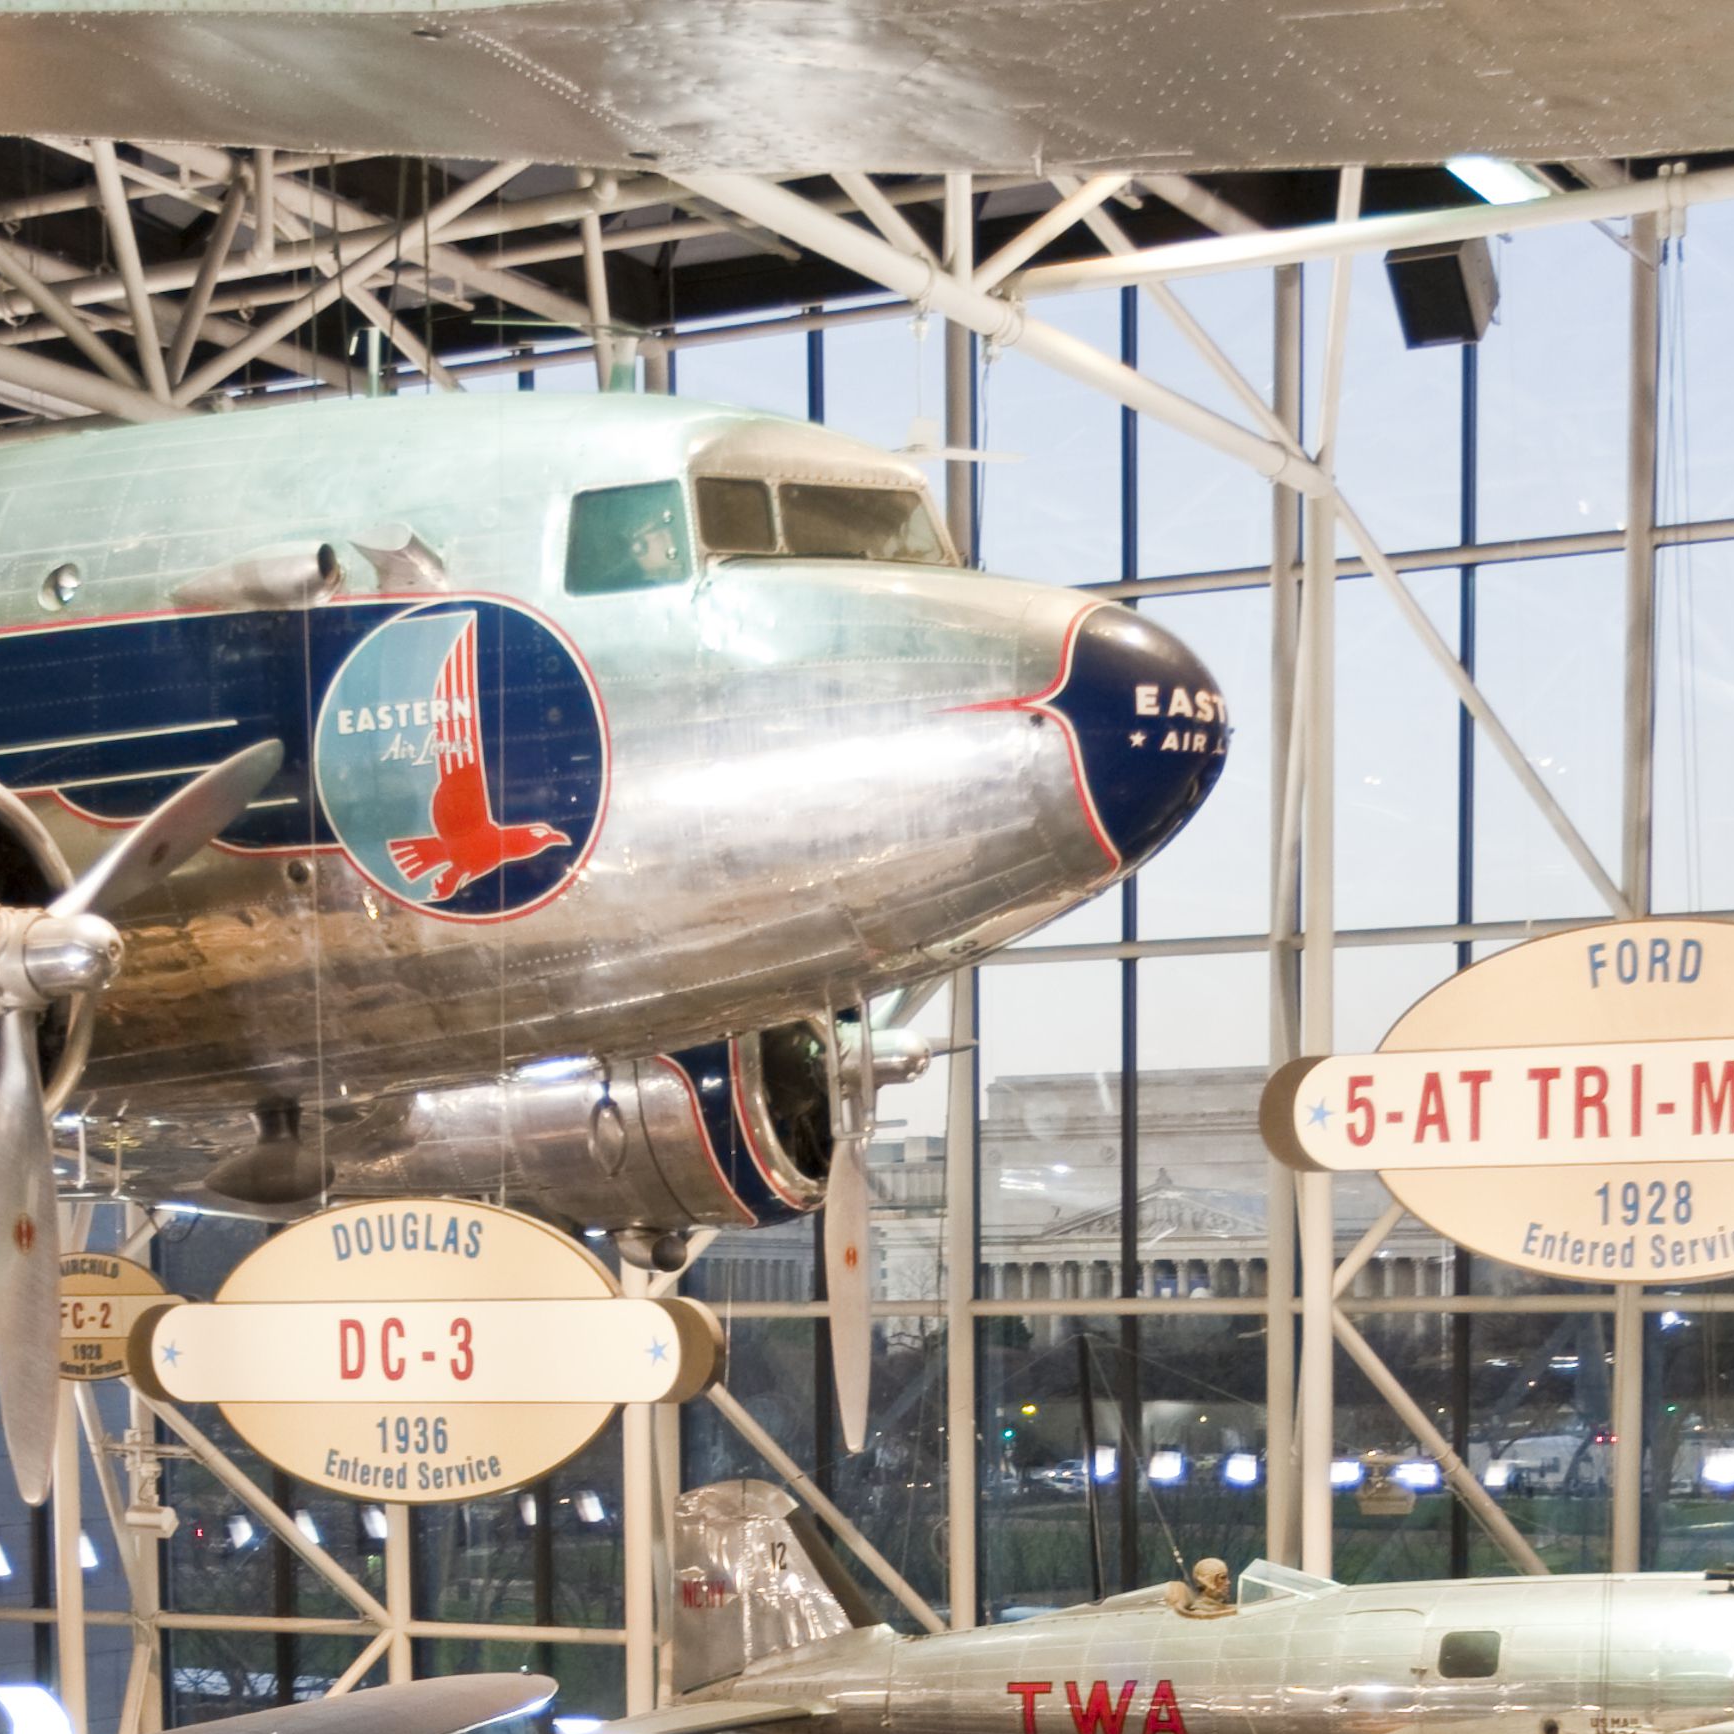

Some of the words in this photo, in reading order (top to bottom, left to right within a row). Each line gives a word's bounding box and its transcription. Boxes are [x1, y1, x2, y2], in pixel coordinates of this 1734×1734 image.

[338, 696, 471, 734] EASTERN
[380, 732, 416, 762] Air
[1160, 731, 1207, 752] AIR
[1587, 938, 1704, 988] FORD
[1345, 1069, 1492, 1147] 5-AT
[1595, 1180, 1693, 1226] 1928
[332, 1212, 483, 1261] DOUGLAS
[1522, 1222, 1635, 1268] Entered
[72, 1344, 102, 1360] 1928
[339, 1317, 474, 1381] DC-3
[376, 1416, 448, 1454] 1936
[324, 1449, 407, 1490] Entered
[417, 1455, 502, 1490] Service
[770, 1541, 787, 1570] 12
